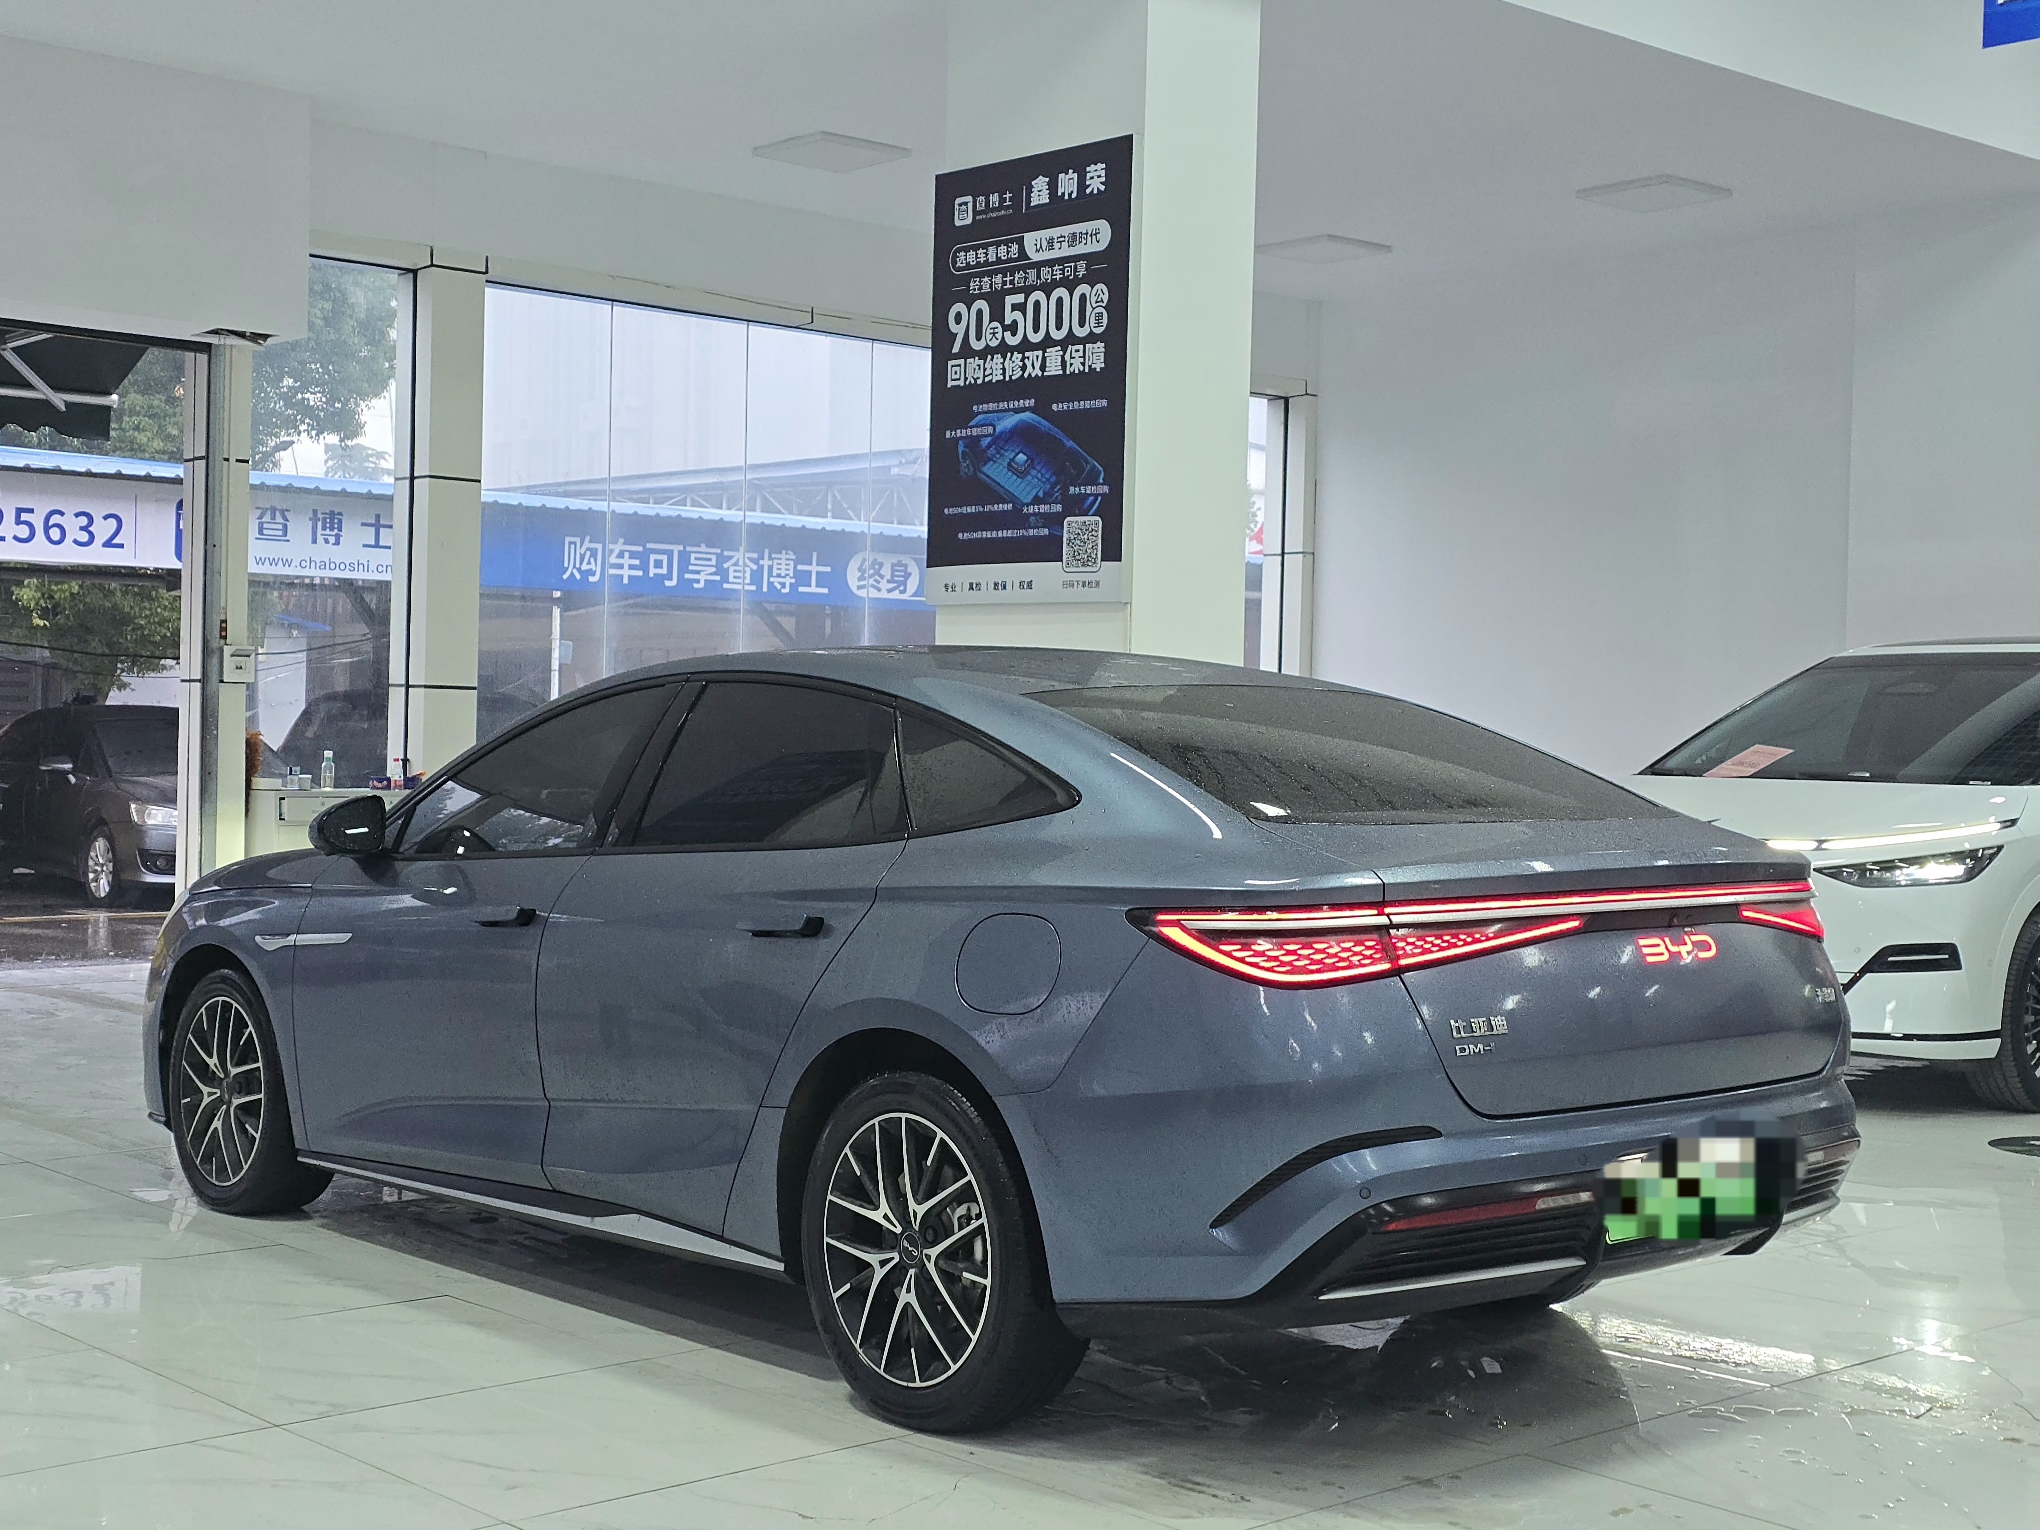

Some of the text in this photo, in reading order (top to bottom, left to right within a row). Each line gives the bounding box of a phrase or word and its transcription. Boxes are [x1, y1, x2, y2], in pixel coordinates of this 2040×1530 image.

[976, 163, 1106, 211] 查博士 鑫响荣
[956, 228, 1100, 267] 选电车看电池 认准宁德时代
[947, 341, 1105, 388] 回购维修双重保障
[0, 506, 125, 549] 5632
[255, 505, 393, 550] 查博士
[255, 555, 392, 575] www.chaboshi.cn
[562, 535, 913, 596] 购车可享查博士 终身
[1062, 579, 1101, 590] 扫码下单检测
[943, 582, 956, 592] 专业
[1637, 934, 1717, 964] BYD
[1450, 1015, 1508, 1038] 比亚迪
